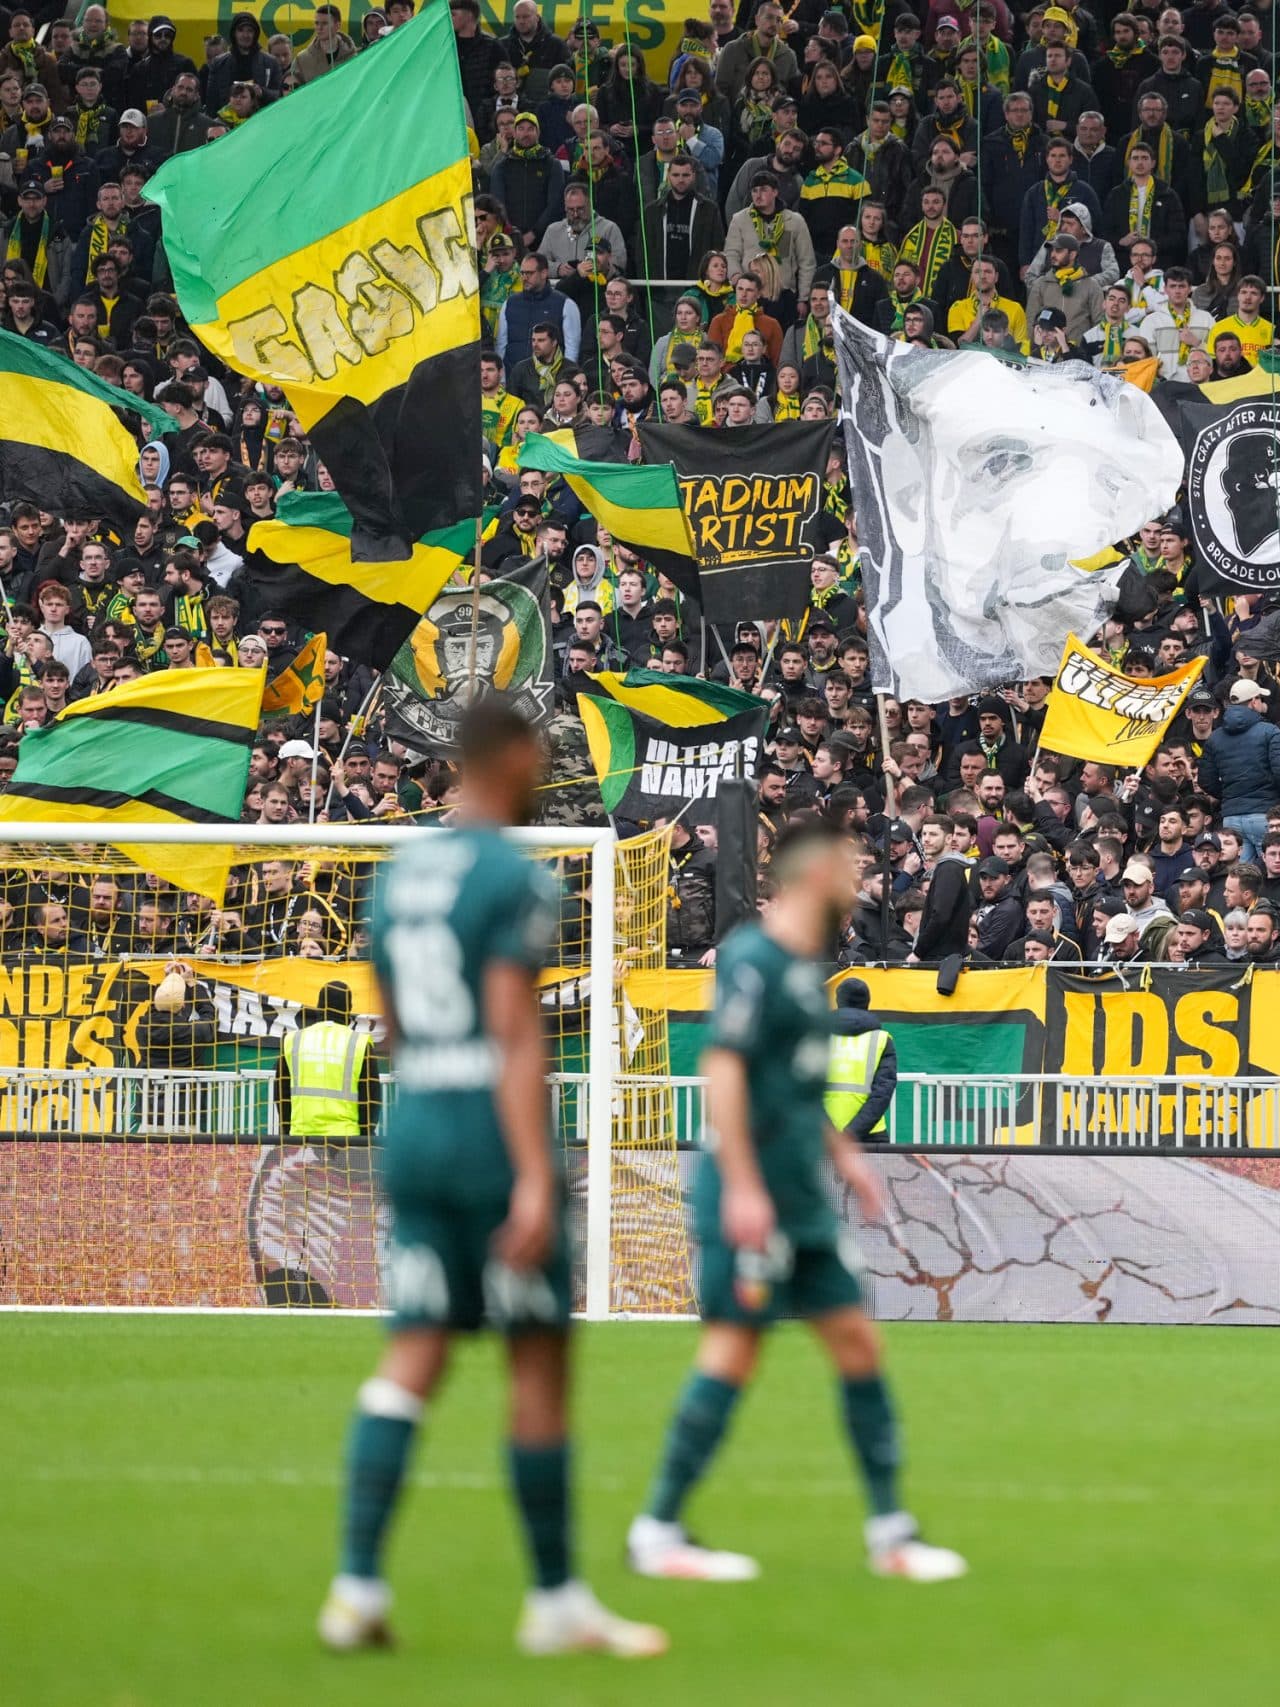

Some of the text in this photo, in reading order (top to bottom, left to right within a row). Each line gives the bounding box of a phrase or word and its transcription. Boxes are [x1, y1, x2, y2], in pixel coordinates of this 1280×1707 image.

[1192, 468, 1202, 498] STILL
[1197, 426, 1223, 463] CRAZY
[1225, 410, 1256, 433] AFTER
[679, 476, 813, 516] TADIUM
[1206, 541, 1255, 580] BRIGADE
[645, 736, 758, 766] ULTRAS
[1061, 991, 1240, 1090] IDS
[1062, 1092, 1238, 1135] NANTES
